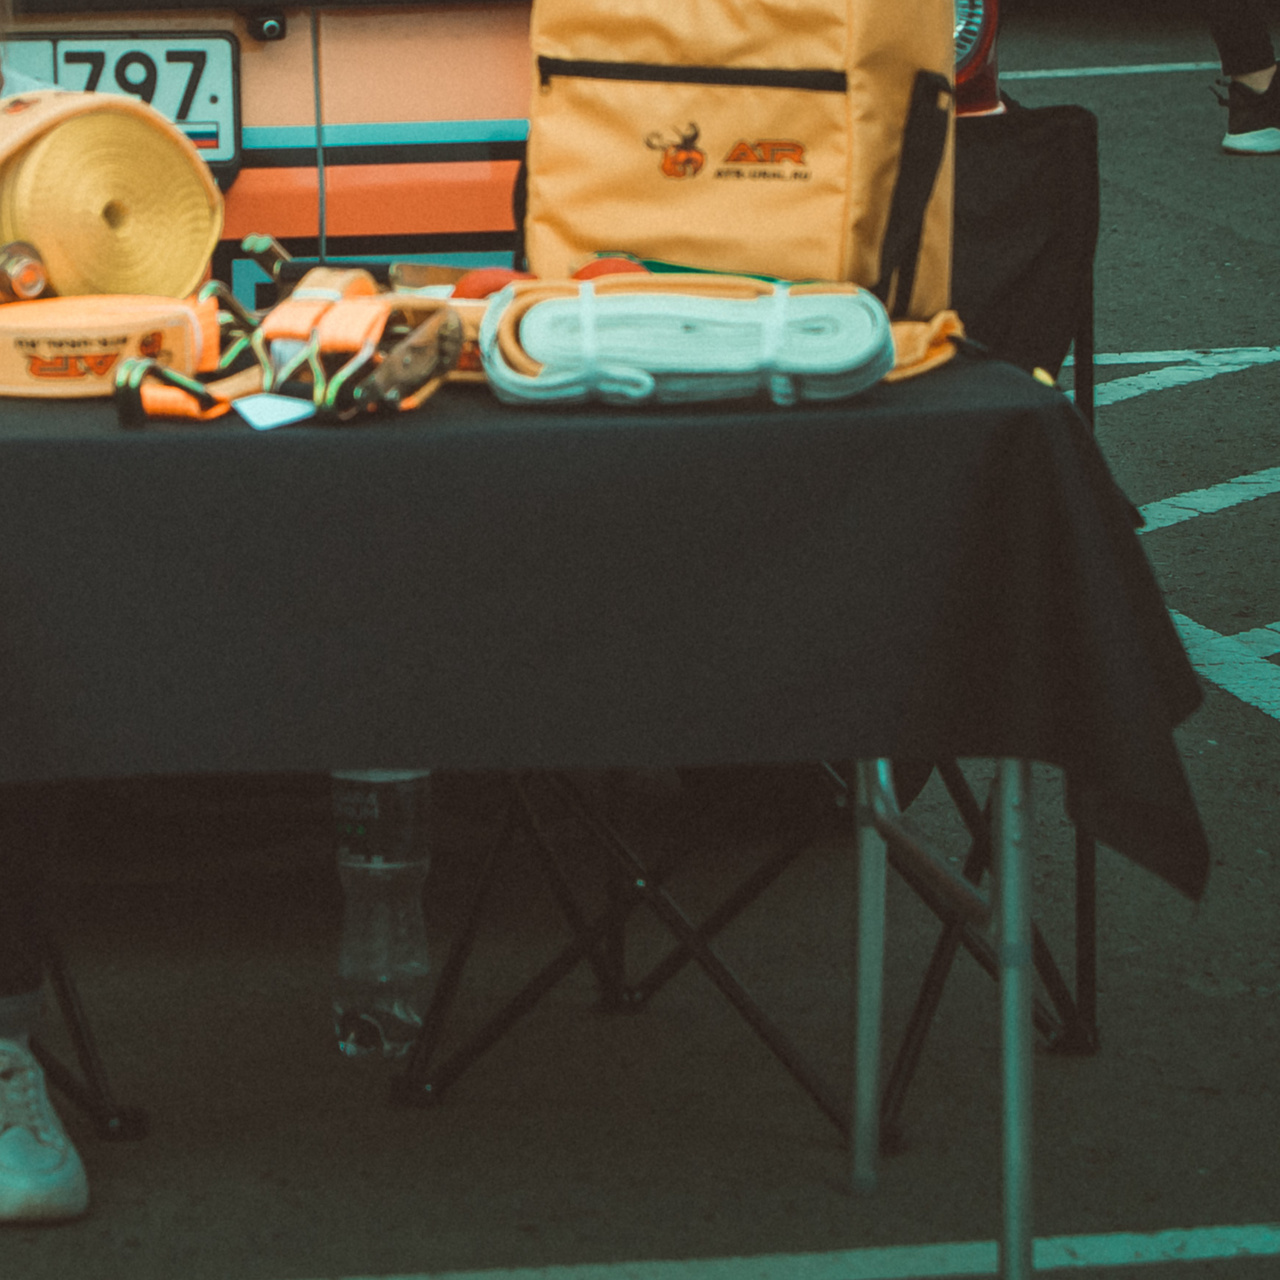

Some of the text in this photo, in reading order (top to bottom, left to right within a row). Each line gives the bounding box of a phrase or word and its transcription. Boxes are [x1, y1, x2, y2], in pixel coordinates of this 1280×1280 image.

[63, 51, 208, 120] 797
[724, 141, 807, 166] ATR
[29, 354, 119, 378] ATR
